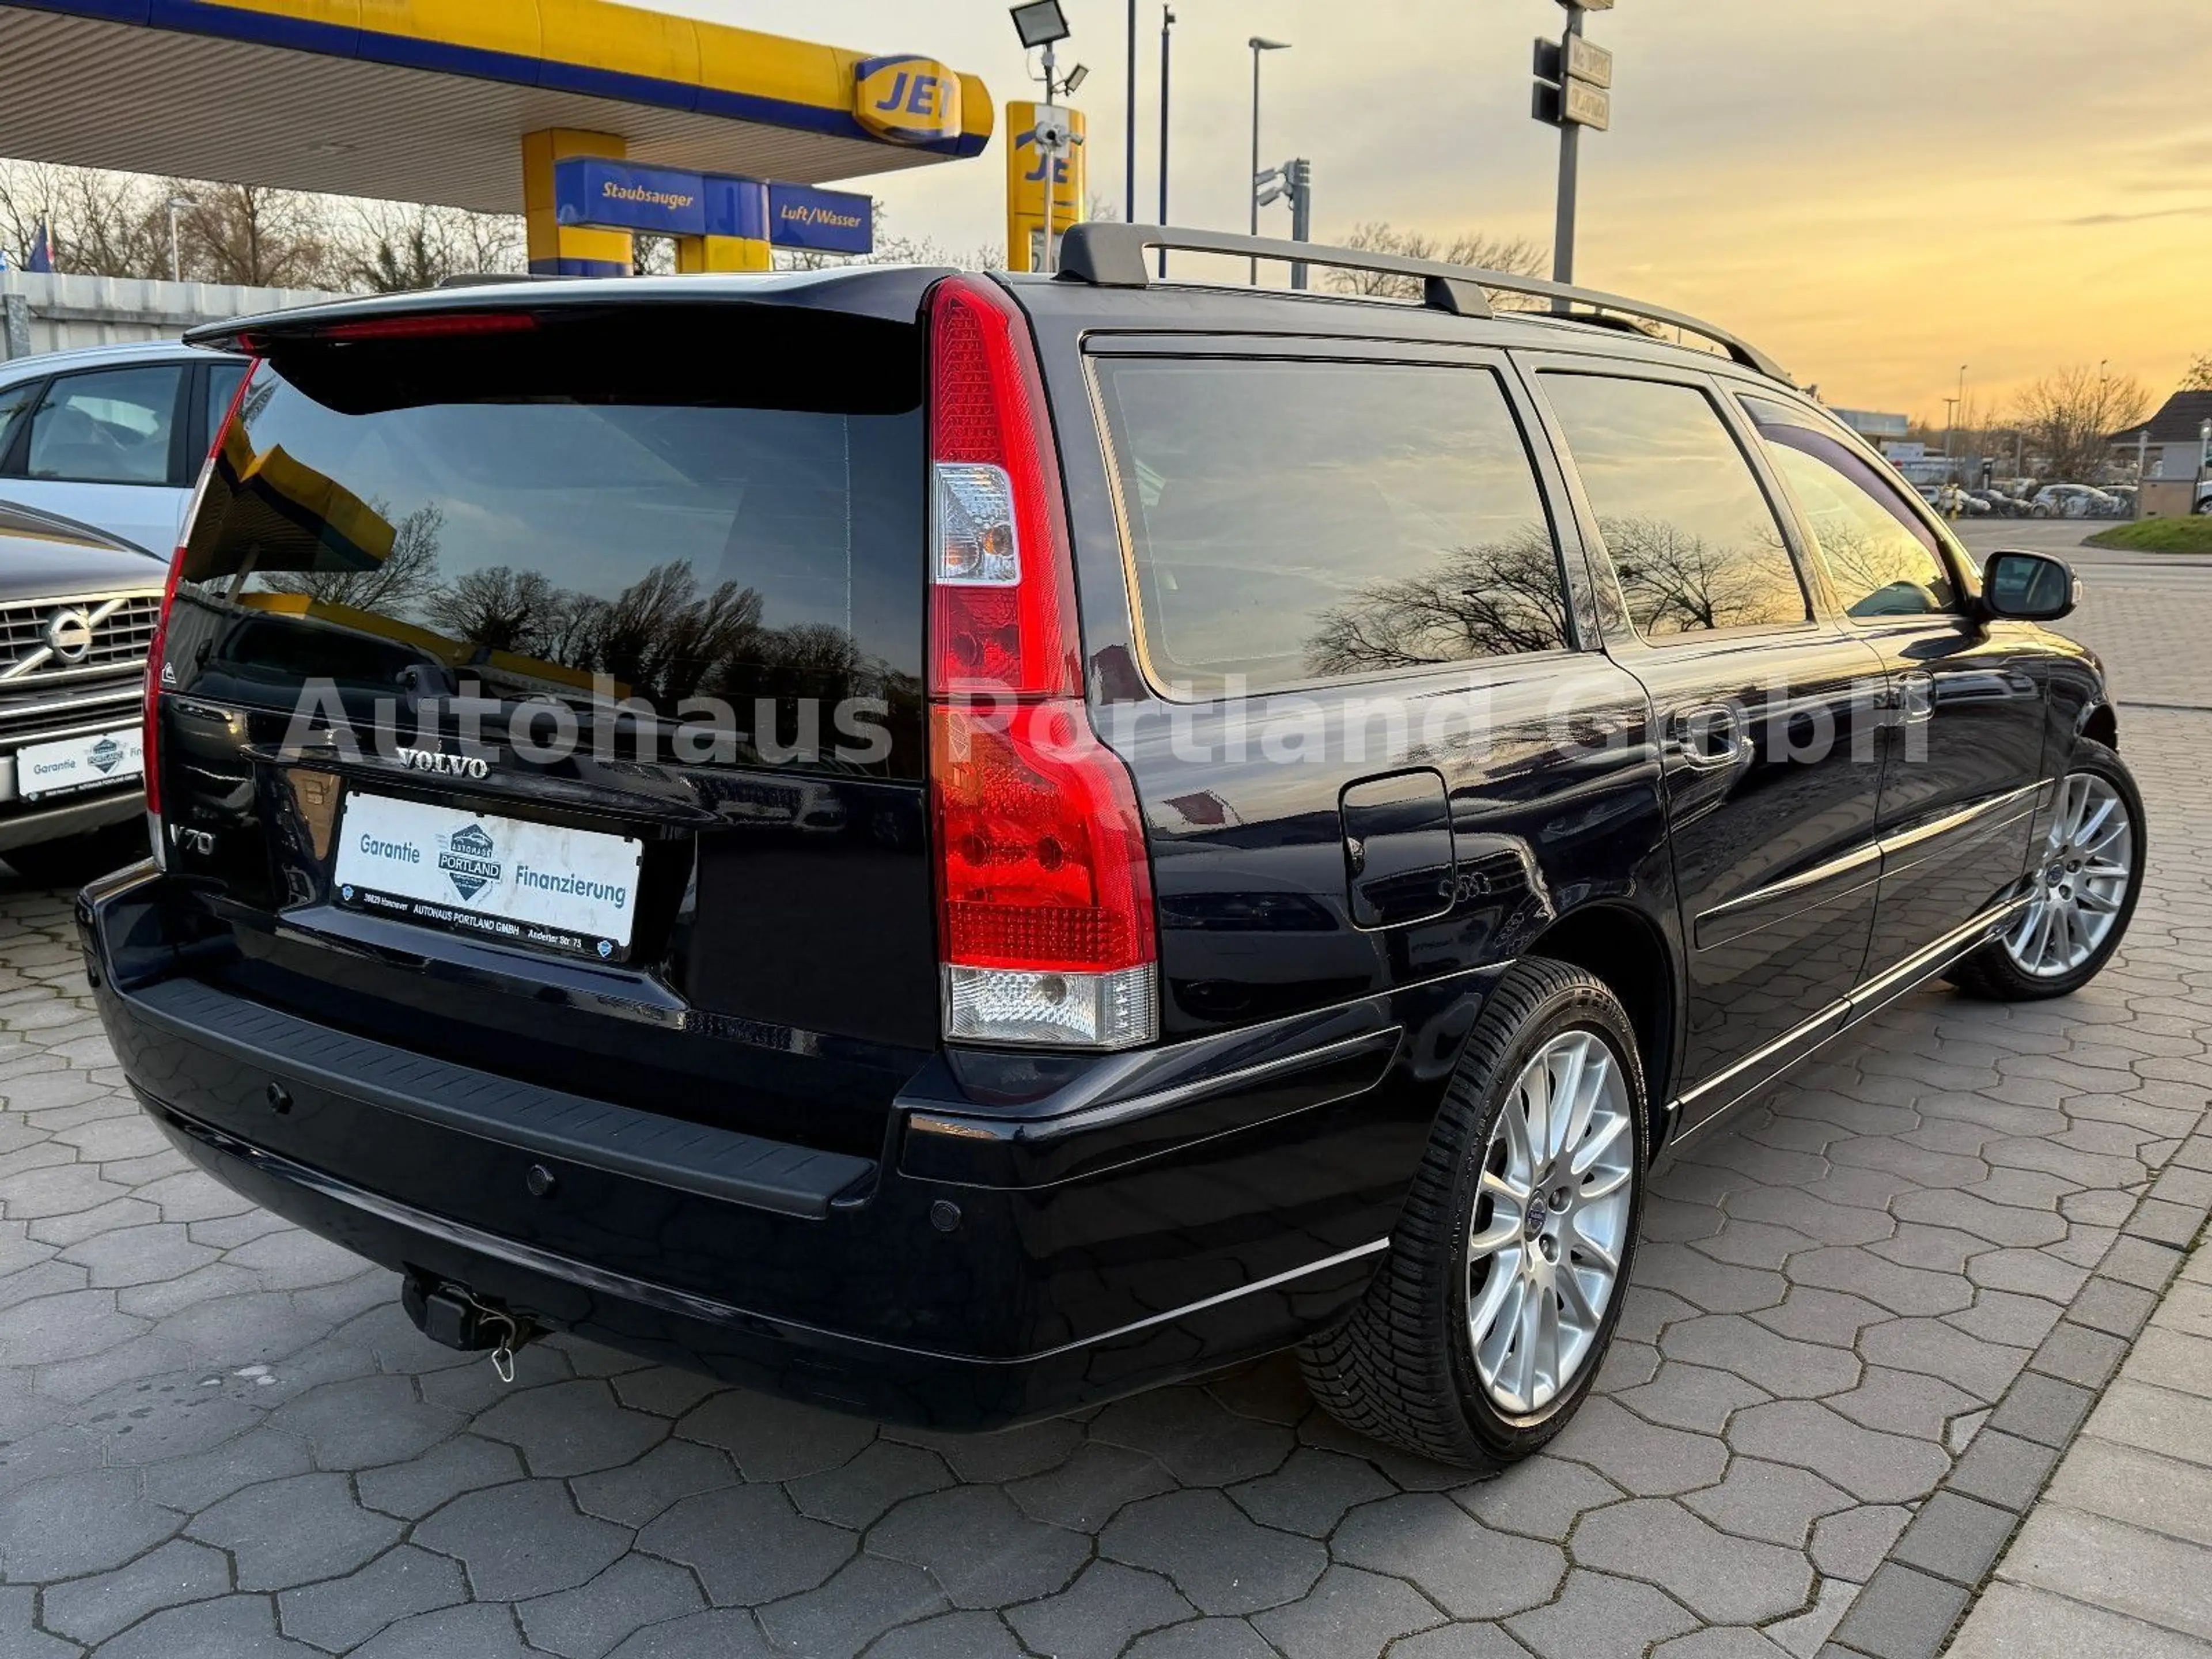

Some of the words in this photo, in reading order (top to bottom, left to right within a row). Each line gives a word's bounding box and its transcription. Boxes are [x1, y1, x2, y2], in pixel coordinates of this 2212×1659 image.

[876, 73, 953, 118] JET
[603, 181, 693, 210] Staubsauger
[781, 204, 862, 228] Luft/Wasser
[33, 759, 76, 775] Garantie
[395, 747, 488, 778] VOLVO
[169, 823, 215, 855] V70
[360, 833, 421, 863] Garantie
[441, 855, 499, 876] PORTLAND
[516, 865, 626, 909] Finanzierung
[413, 904, 453, 922] AUTOHAUS
[453, 912, 494, 930] PORTLAND
